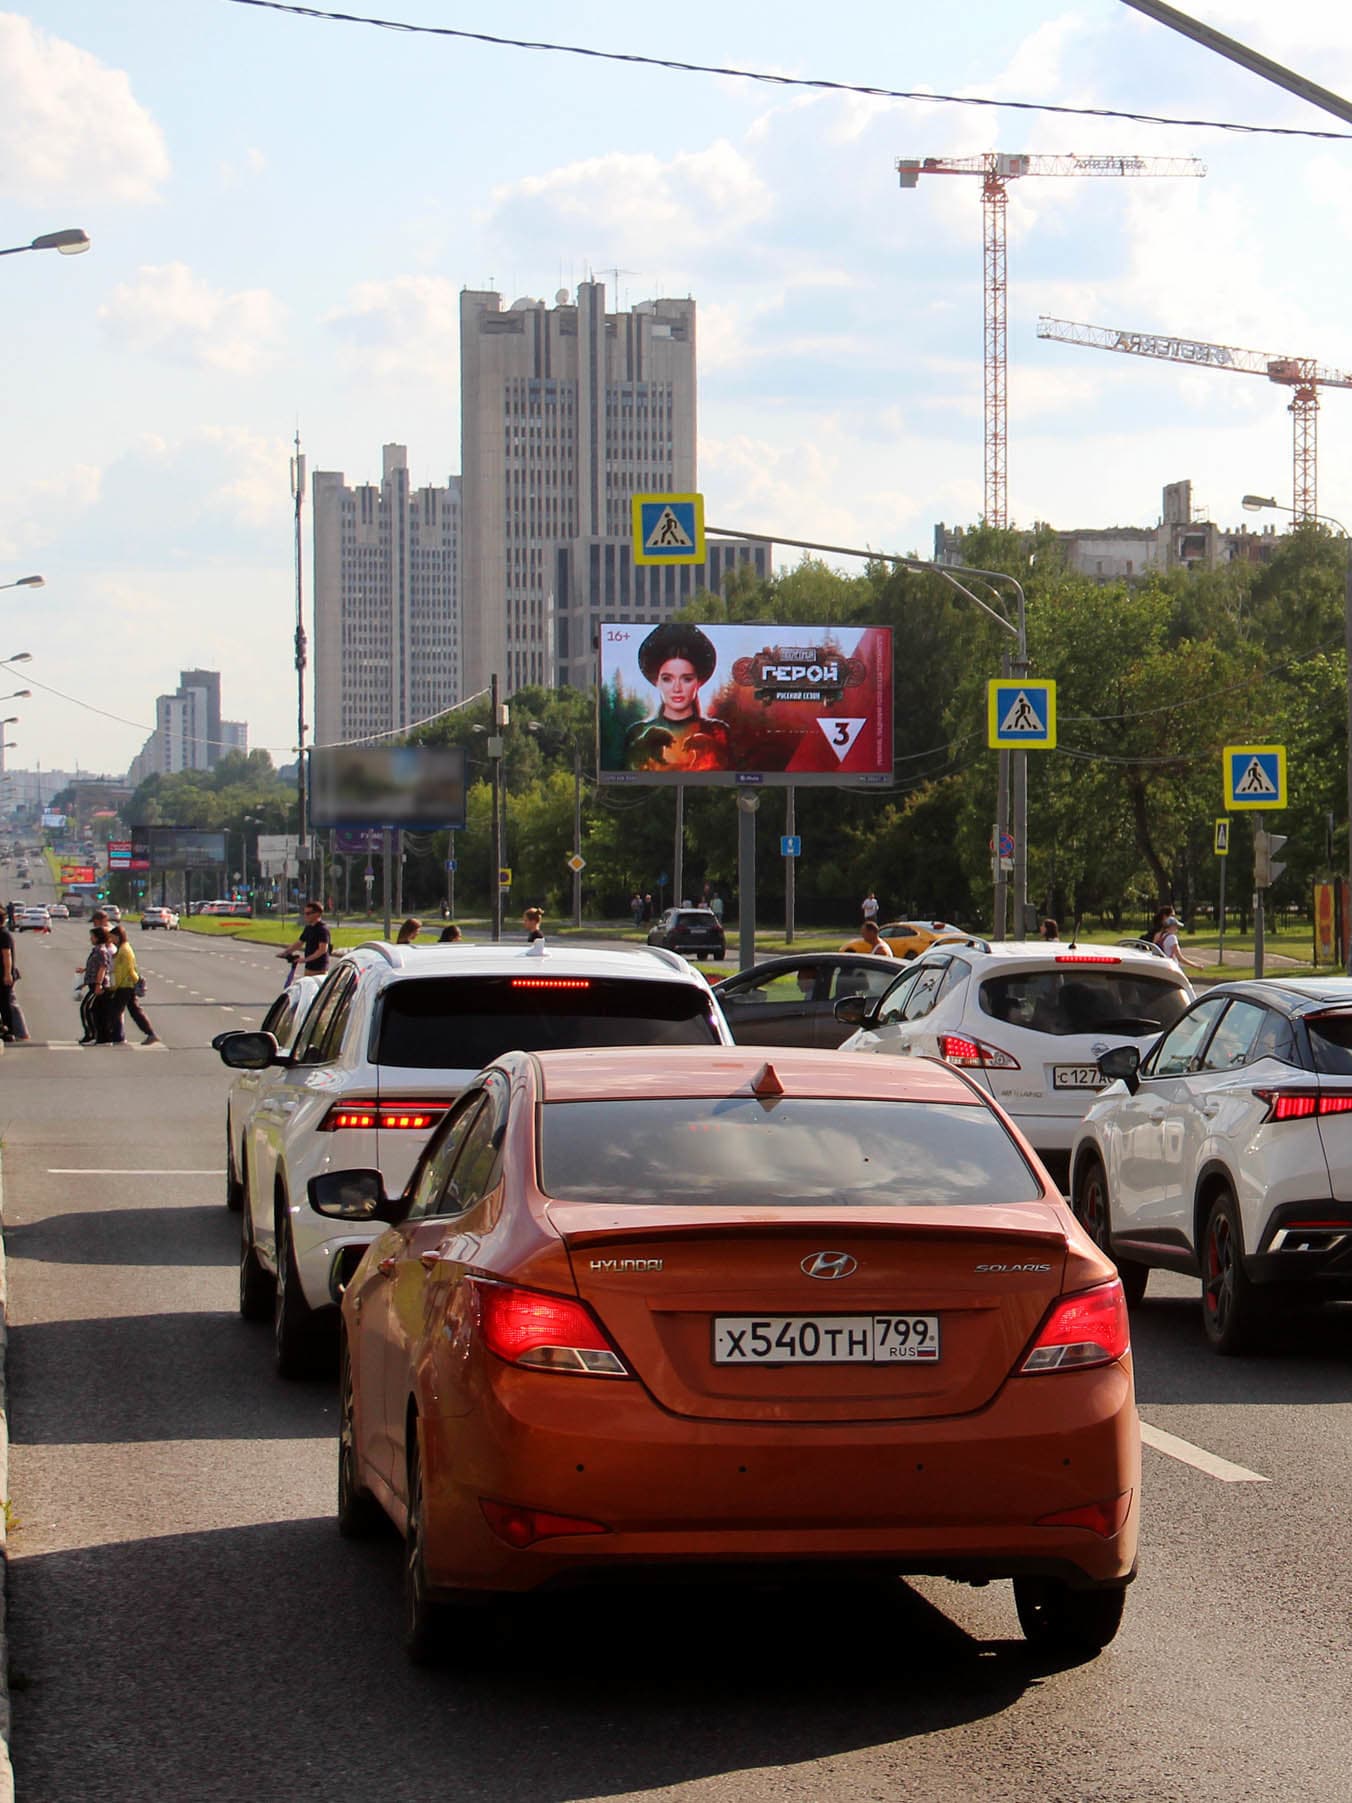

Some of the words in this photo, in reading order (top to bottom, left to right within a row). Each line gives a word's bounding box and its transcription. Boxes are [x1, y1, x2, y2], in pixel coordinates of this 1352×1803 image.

[608, 632, 631, 641] 16+
[762, 661, 838, 682] ГЕРОЙ
[834, 723, 849, 746] 3
[590, 1259, 663, 1272] HYUNDAI
[974, 1264, 1051, 1273] SOLARIS
[875, 1318, 929, 1346] 799
[889, 1346, 917, 1358] RUS
